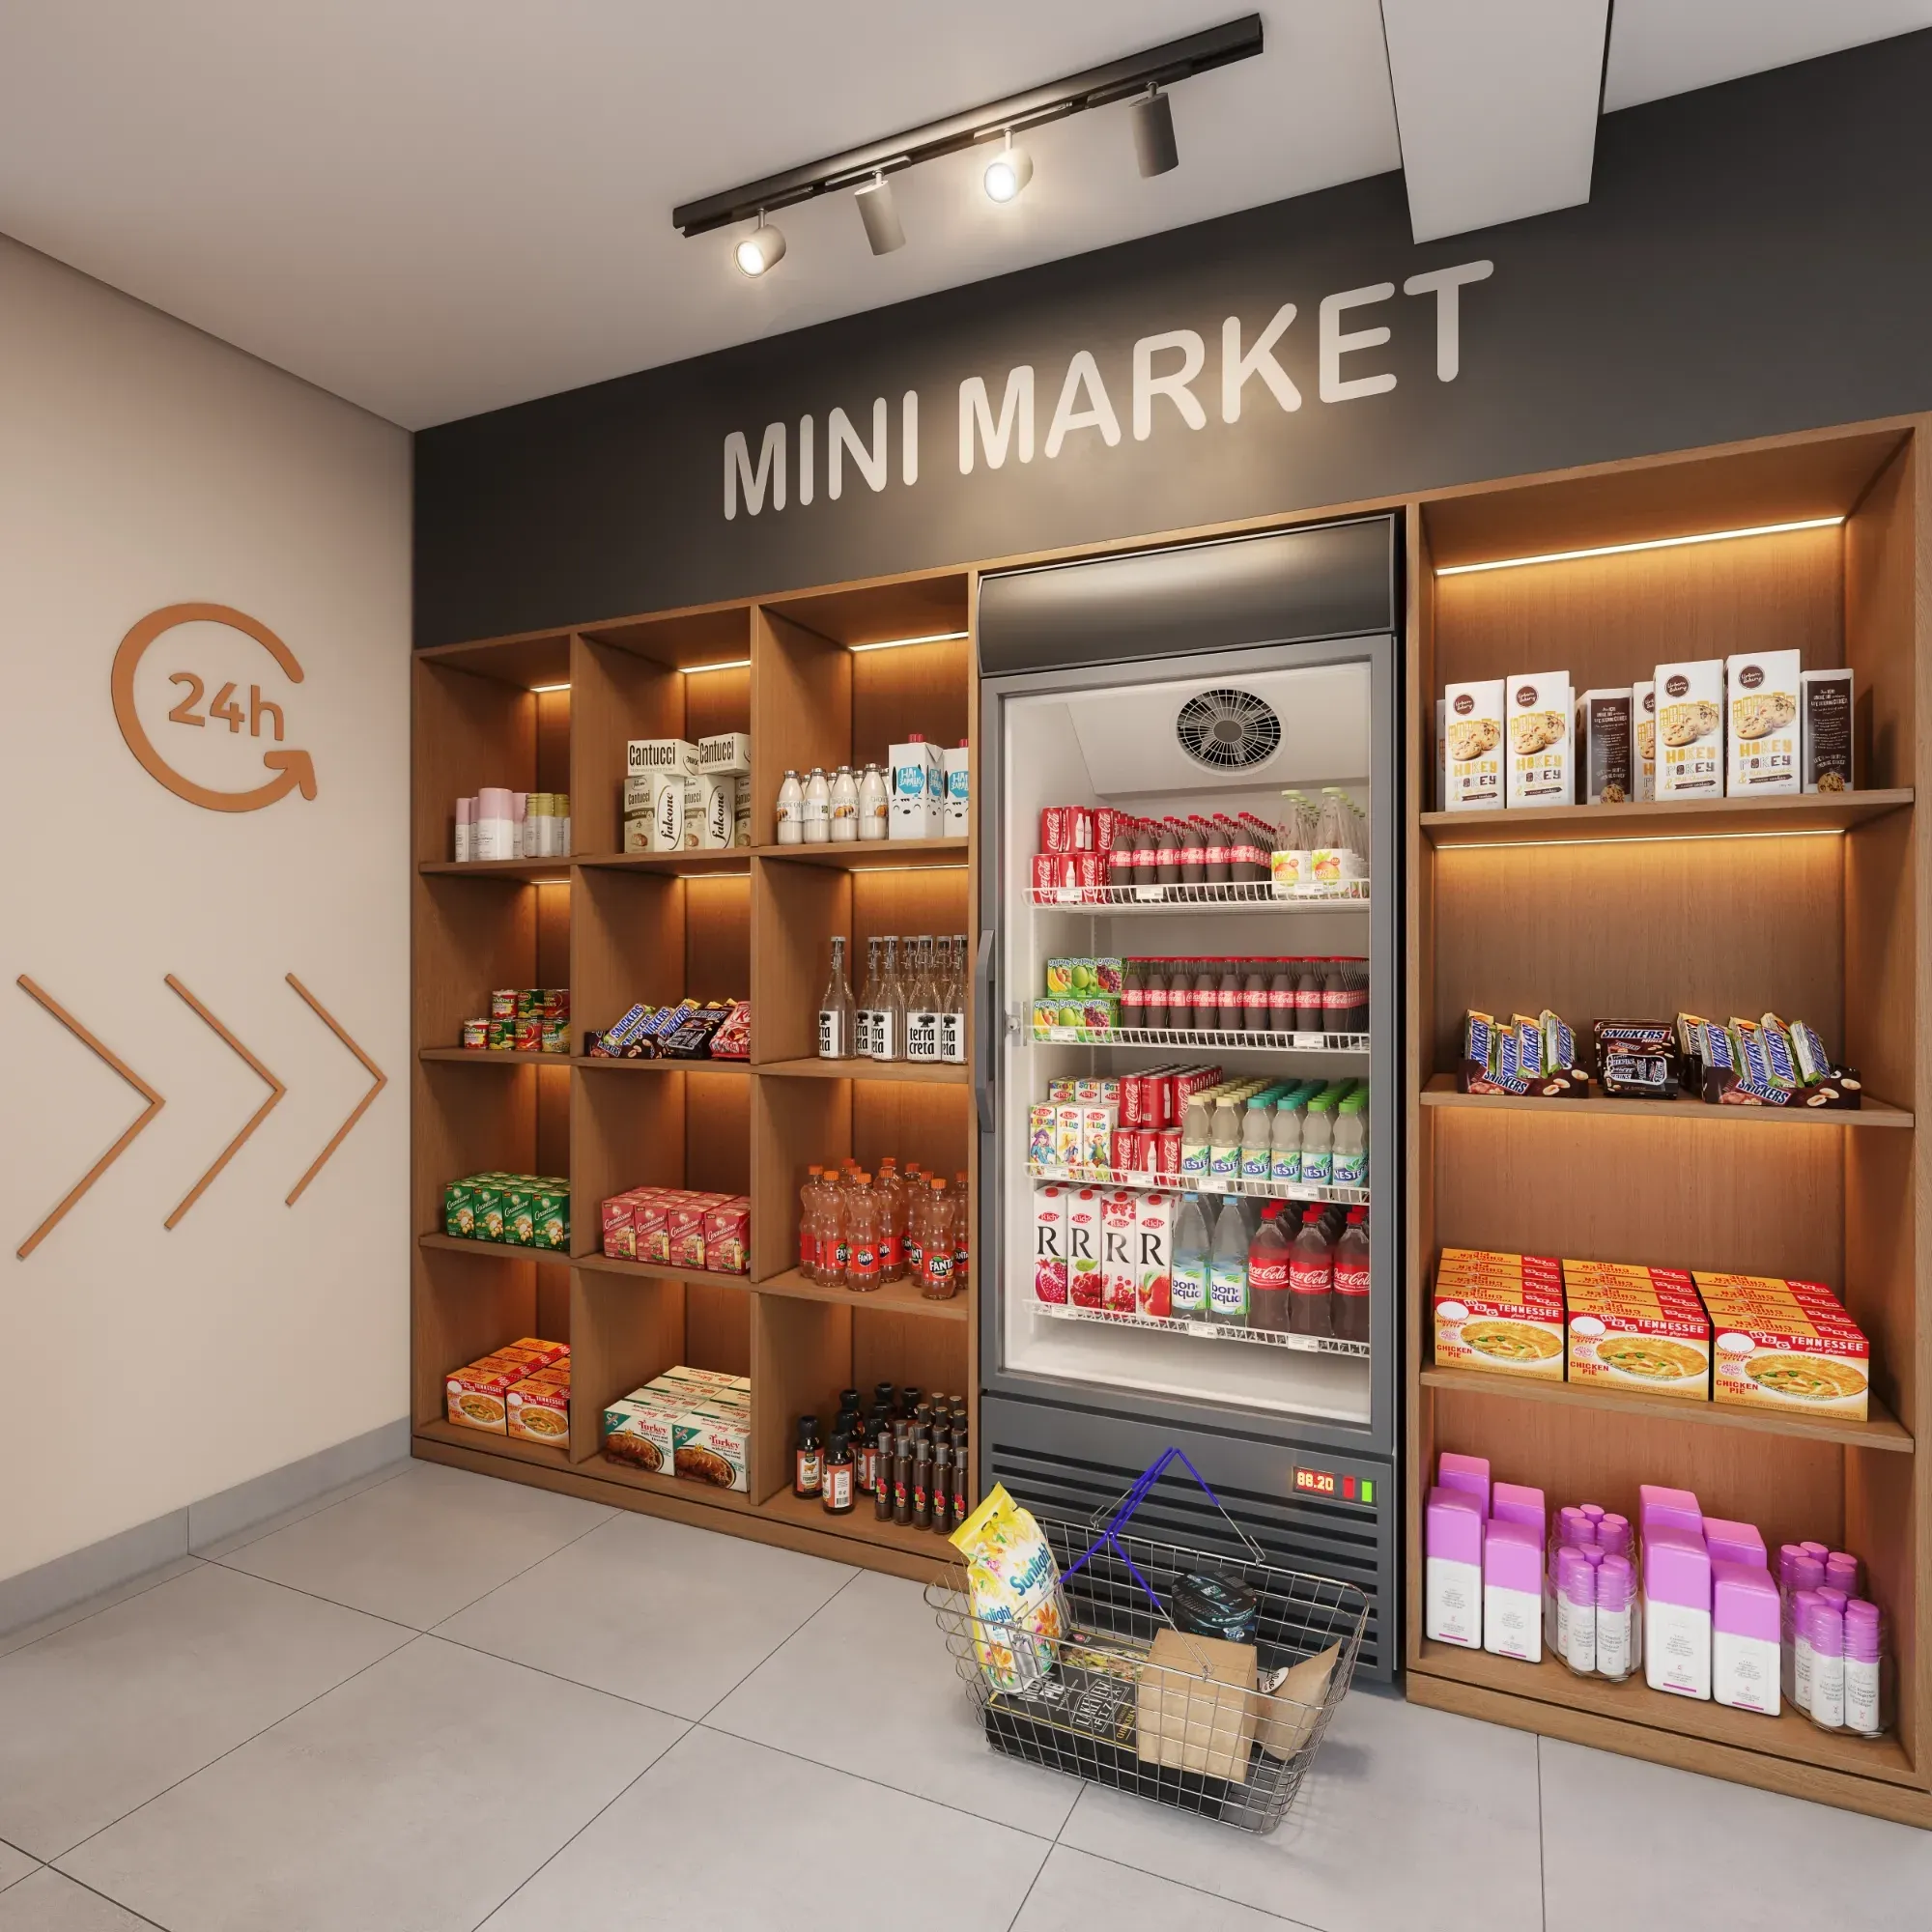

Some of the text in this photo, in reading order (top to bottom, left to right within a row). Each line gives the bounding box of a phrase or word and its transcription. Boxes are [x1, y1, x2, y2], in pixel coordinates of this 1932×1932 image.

[724, 259, 1494, 522] MINI MARKET
[168, 672, 284, 742] 24h
[629, 742, 676, 766] Cantucci
[699, 736, 734, 764] Cantucci
[1665, 747, 1716, 764] HOKEY
[1740, 739, 1792, 757] HOKEY
[1454, 761, 1497, 777] HOKEY
[1516, 754, 1562, 771] HOKEY
[1665, 761, 1715, 777] POKEY
[1740, 755, 1792, 770] POKEY
[1454, 776, 1496, 790] POKEY
[1516, 770, 1561, 783] POKEY
[628, 790, 650, 806] Cantucci
[684, 790, 701, 805] ntucci
[661, 792, 675, 842] falcone
[712, 792, 727, 843] falcone
[611, 1004, 645, 1040] SNICKERS
[909, 1027, 934, 1041] terra
[1603, 1029, 1664, 1039] SNICKERS
[909, 1041, 934, 1055] creta
[1521, 1023, 1540, 1073] SNICKERS
[1764, 1028, 1796, 1083] SNICKERS
[1484, 1071, 1528, 1094] SNICKERS
[1738, 1081, 1789, 1104] SNICKERS
[1125, 1082, 1139, 1122] Coca-Cola
[1039, 1212, 1058, 1223] Rich
[1072, 1213, 1090, 1224] Rich
[1110, 1219, 1128, 1228] Rich
[1143, 1218, 1162, 1228] Rich
[1037, 1226, 1061, 1256] R
[1071, 1228, 1094, 1259] R
[1106, 1232, 1130, 1264] R
[836, 1247, 847, 1260] FAN
[1140, 1233, 1165, 1266] R
[857, 1253, 873, 1264] FANTA
[929, 1260, 953, 1272] FANTA
[1498, 1303, 1559, 1318] TENNESSEE
[1637, 1319, 1704, 1333] TENNESSEE
[1436, 1344, 1472, 1354] CHICKEN
[1790, 1336, 1863, 1351] TENNESSEE
[1570, 1361, 1609, 1372] CHICKEN
[1716, 1379, 1758, 1391] CHICKEN
[638, 1419, 668, 1435] Turkey
[709, 1434, 740, 1449] Turkey
[1296, 1471, 1334, 1492] 88.20
[1009, 1543, 1051, 1596] Sunlight
